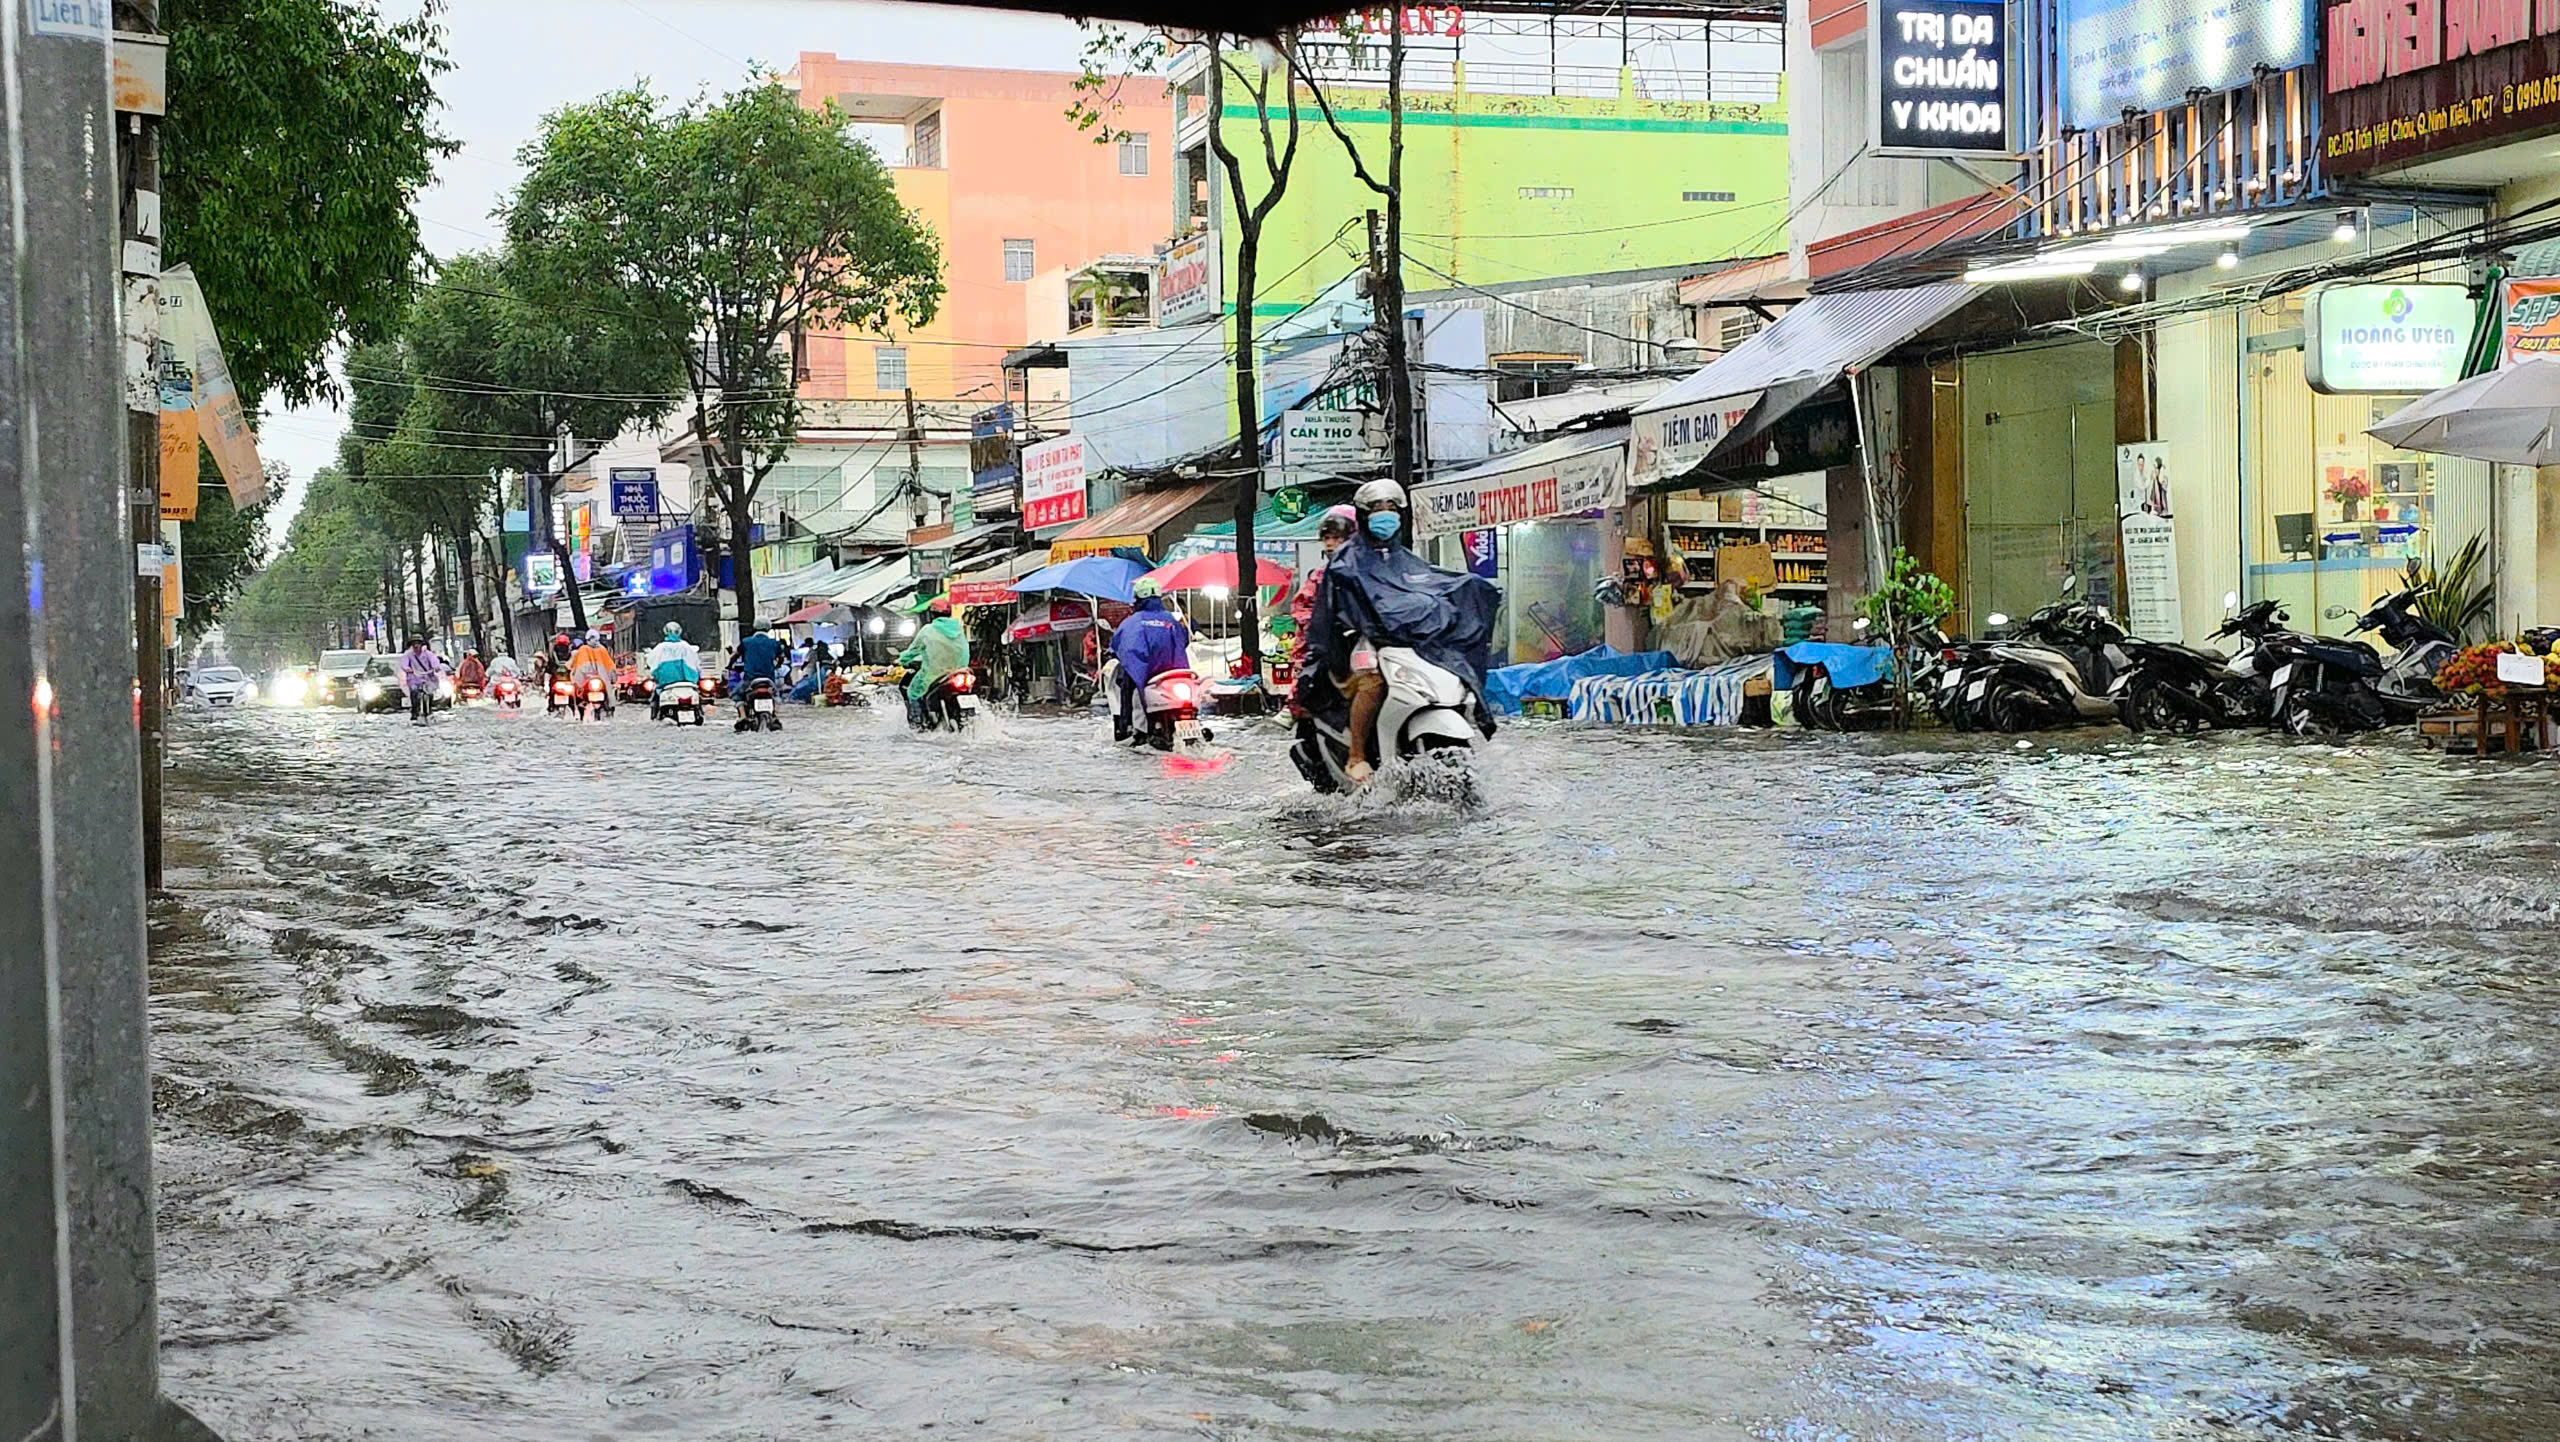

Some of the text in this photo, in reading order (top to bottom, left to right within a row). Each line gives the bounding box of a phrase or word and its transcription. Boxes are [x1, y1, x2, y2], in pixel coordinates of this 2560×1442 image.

[1445, 5, 1466, 37] 2
[1896, 12, 1994, 49] TRỊ DA
[1891, 100, 2001, 133] Y KHOA
[1662, 413, 1691, 453] TIỆM
[1694, 412, 1718, 448] GẠO
[1456, 489, 1476, 513] GẠO
[1478, 479, 1529, 526] HUỲNH
